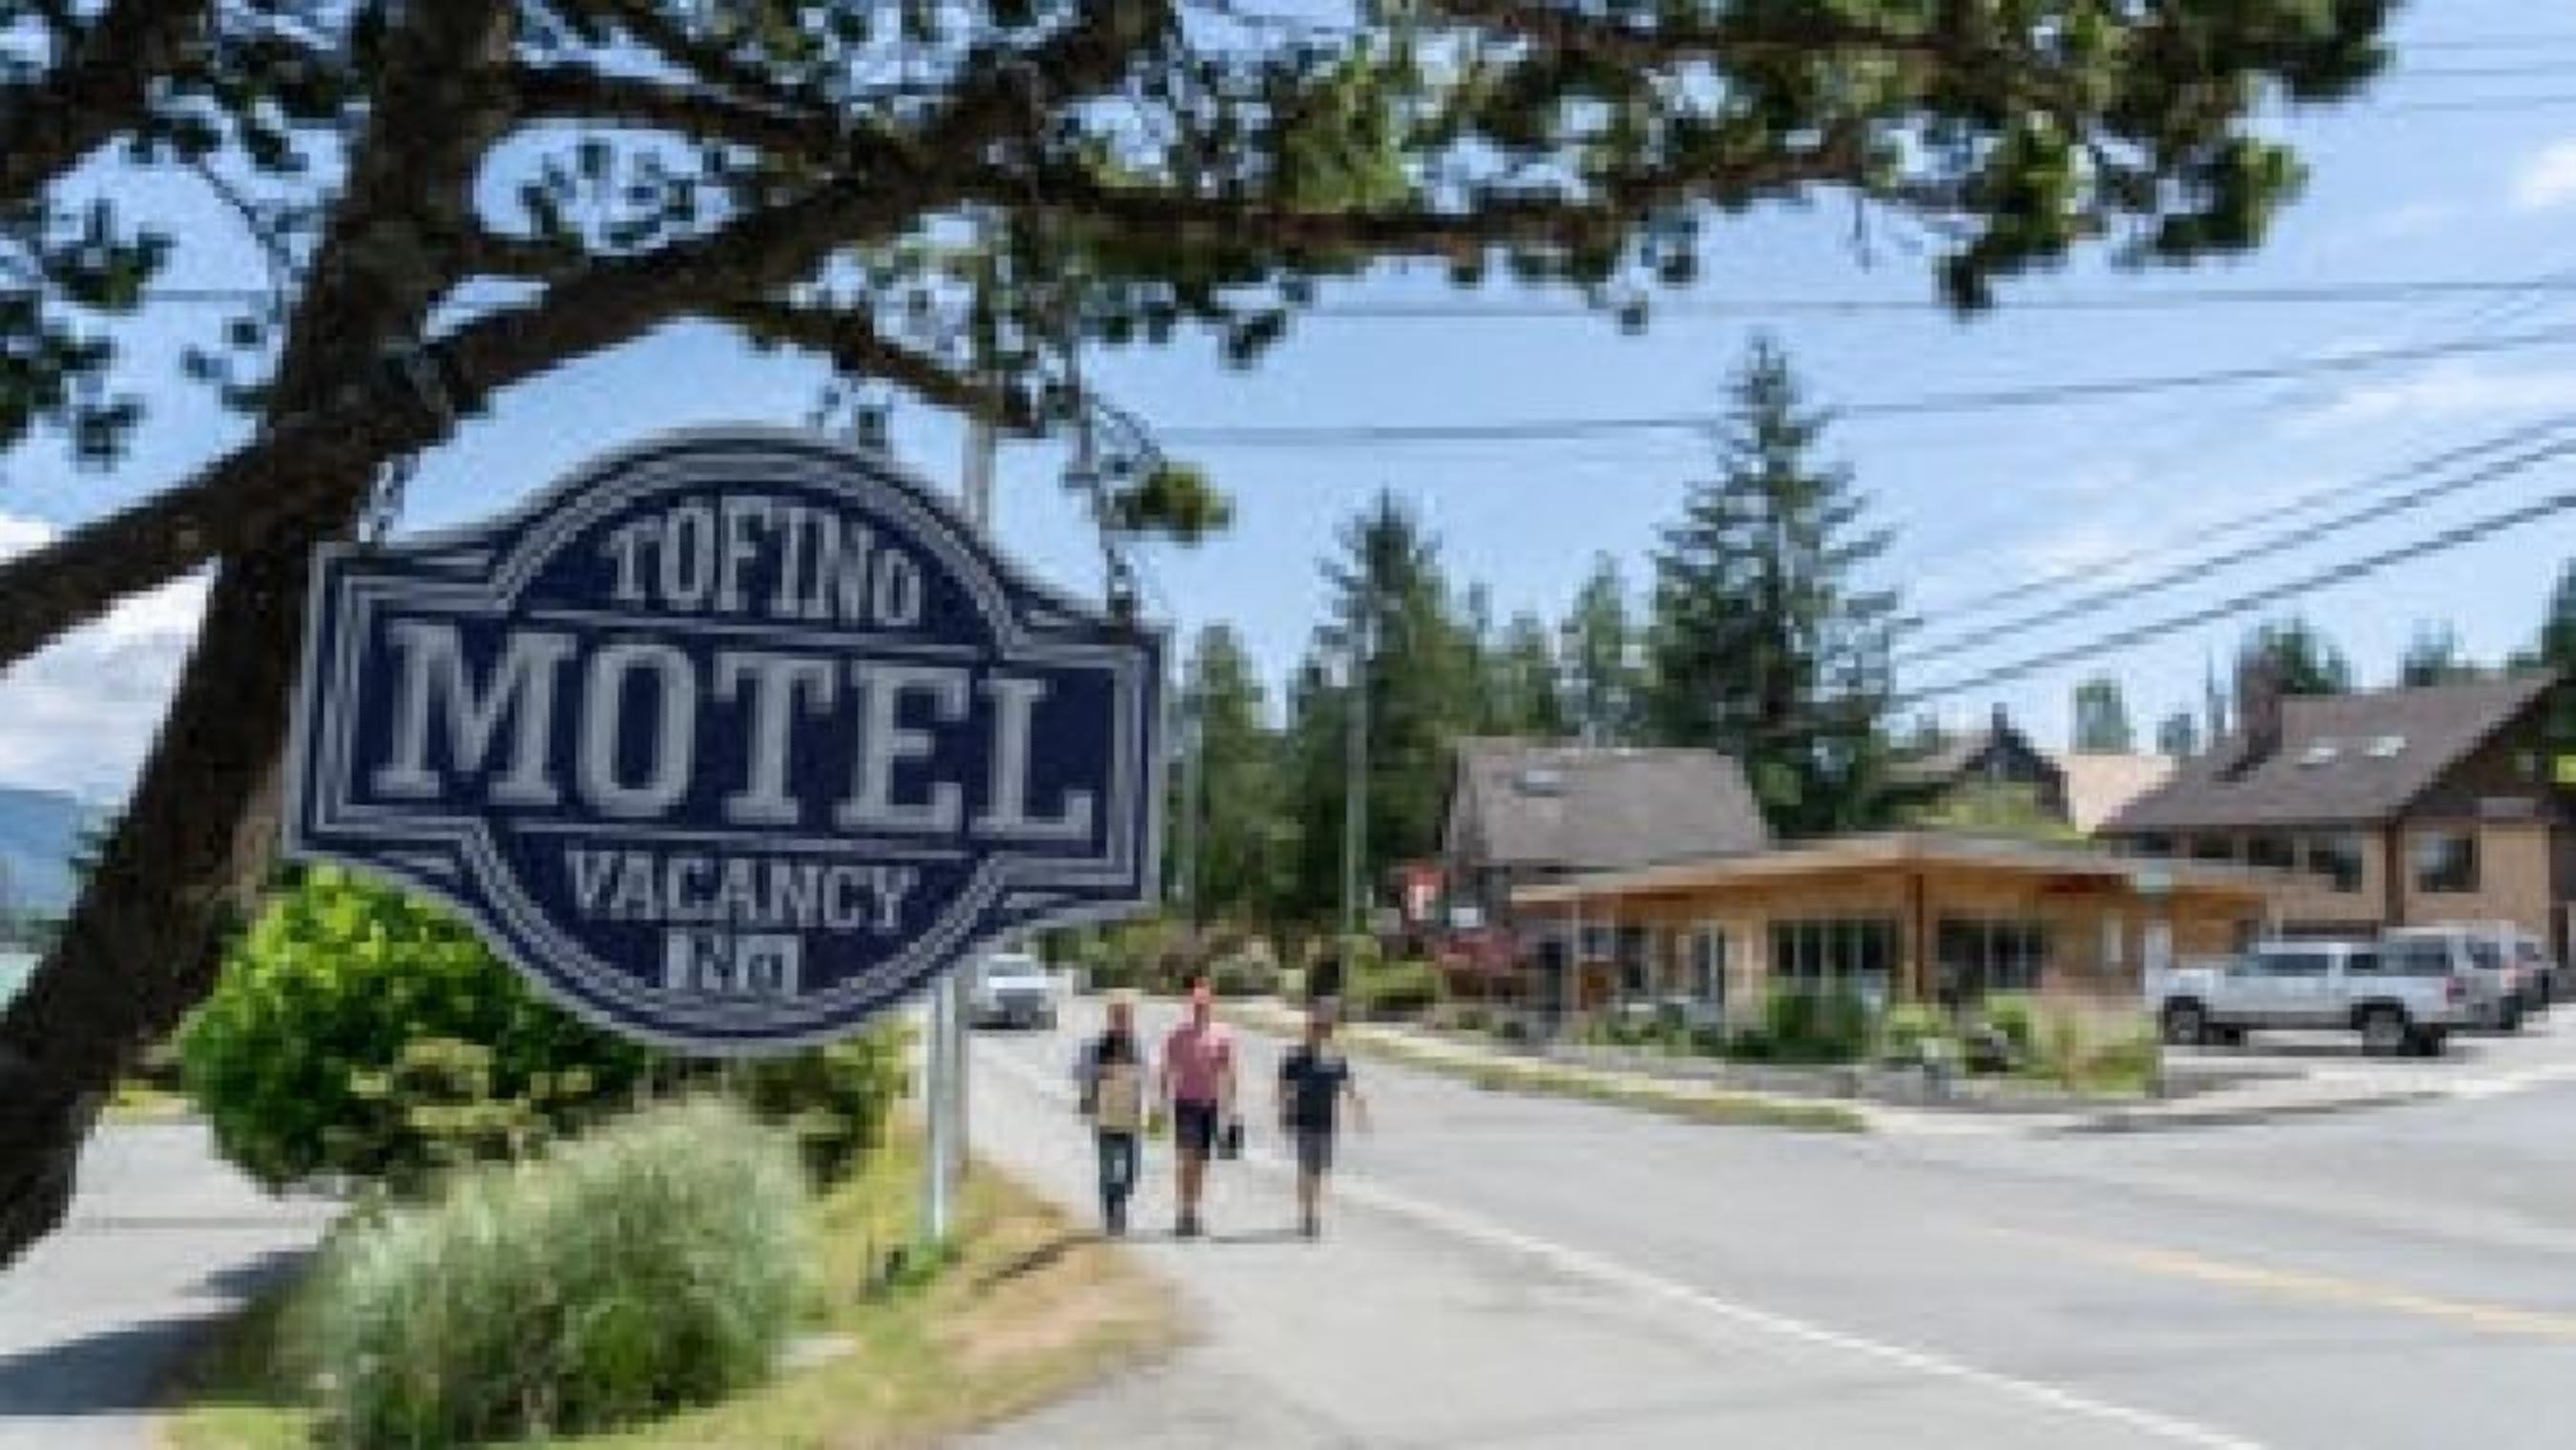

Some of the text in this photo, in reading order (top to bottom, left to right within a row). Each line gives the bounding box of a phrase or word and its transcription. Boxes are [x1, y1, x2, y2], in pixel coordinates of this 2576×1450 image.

[605, 495, 922, 627] TOFINO
[373, 620, 1093, 839] MOTEL
[565, 849, 919, 931] VACANCY
